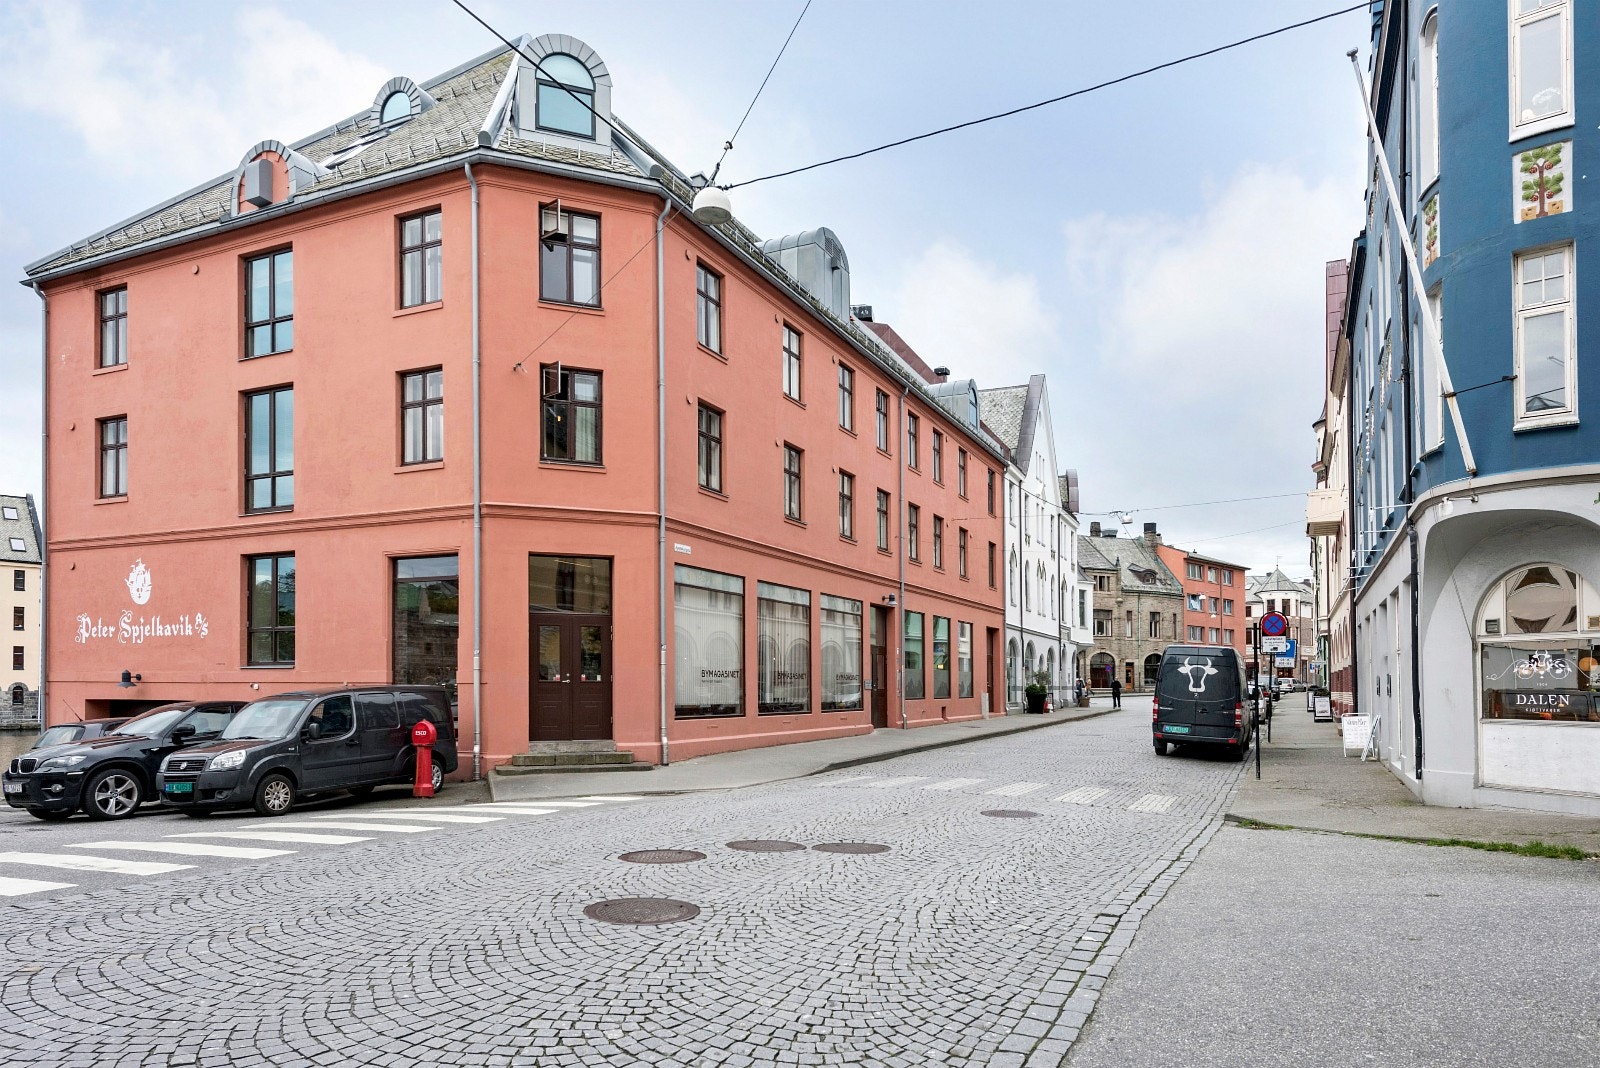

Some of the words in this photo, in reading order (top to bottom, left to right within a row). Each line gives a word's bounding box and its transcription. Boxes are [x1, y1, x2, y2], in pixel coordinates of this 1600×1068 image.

[75, 612, 115, 643] Peter
[118, 610, 192, 644] Spjelkavik
[195, 612, 208, 639] A/S
[701, 669, 739, 678] BYMAGASINET
[1516, 694, 1570, 706] DALEN
